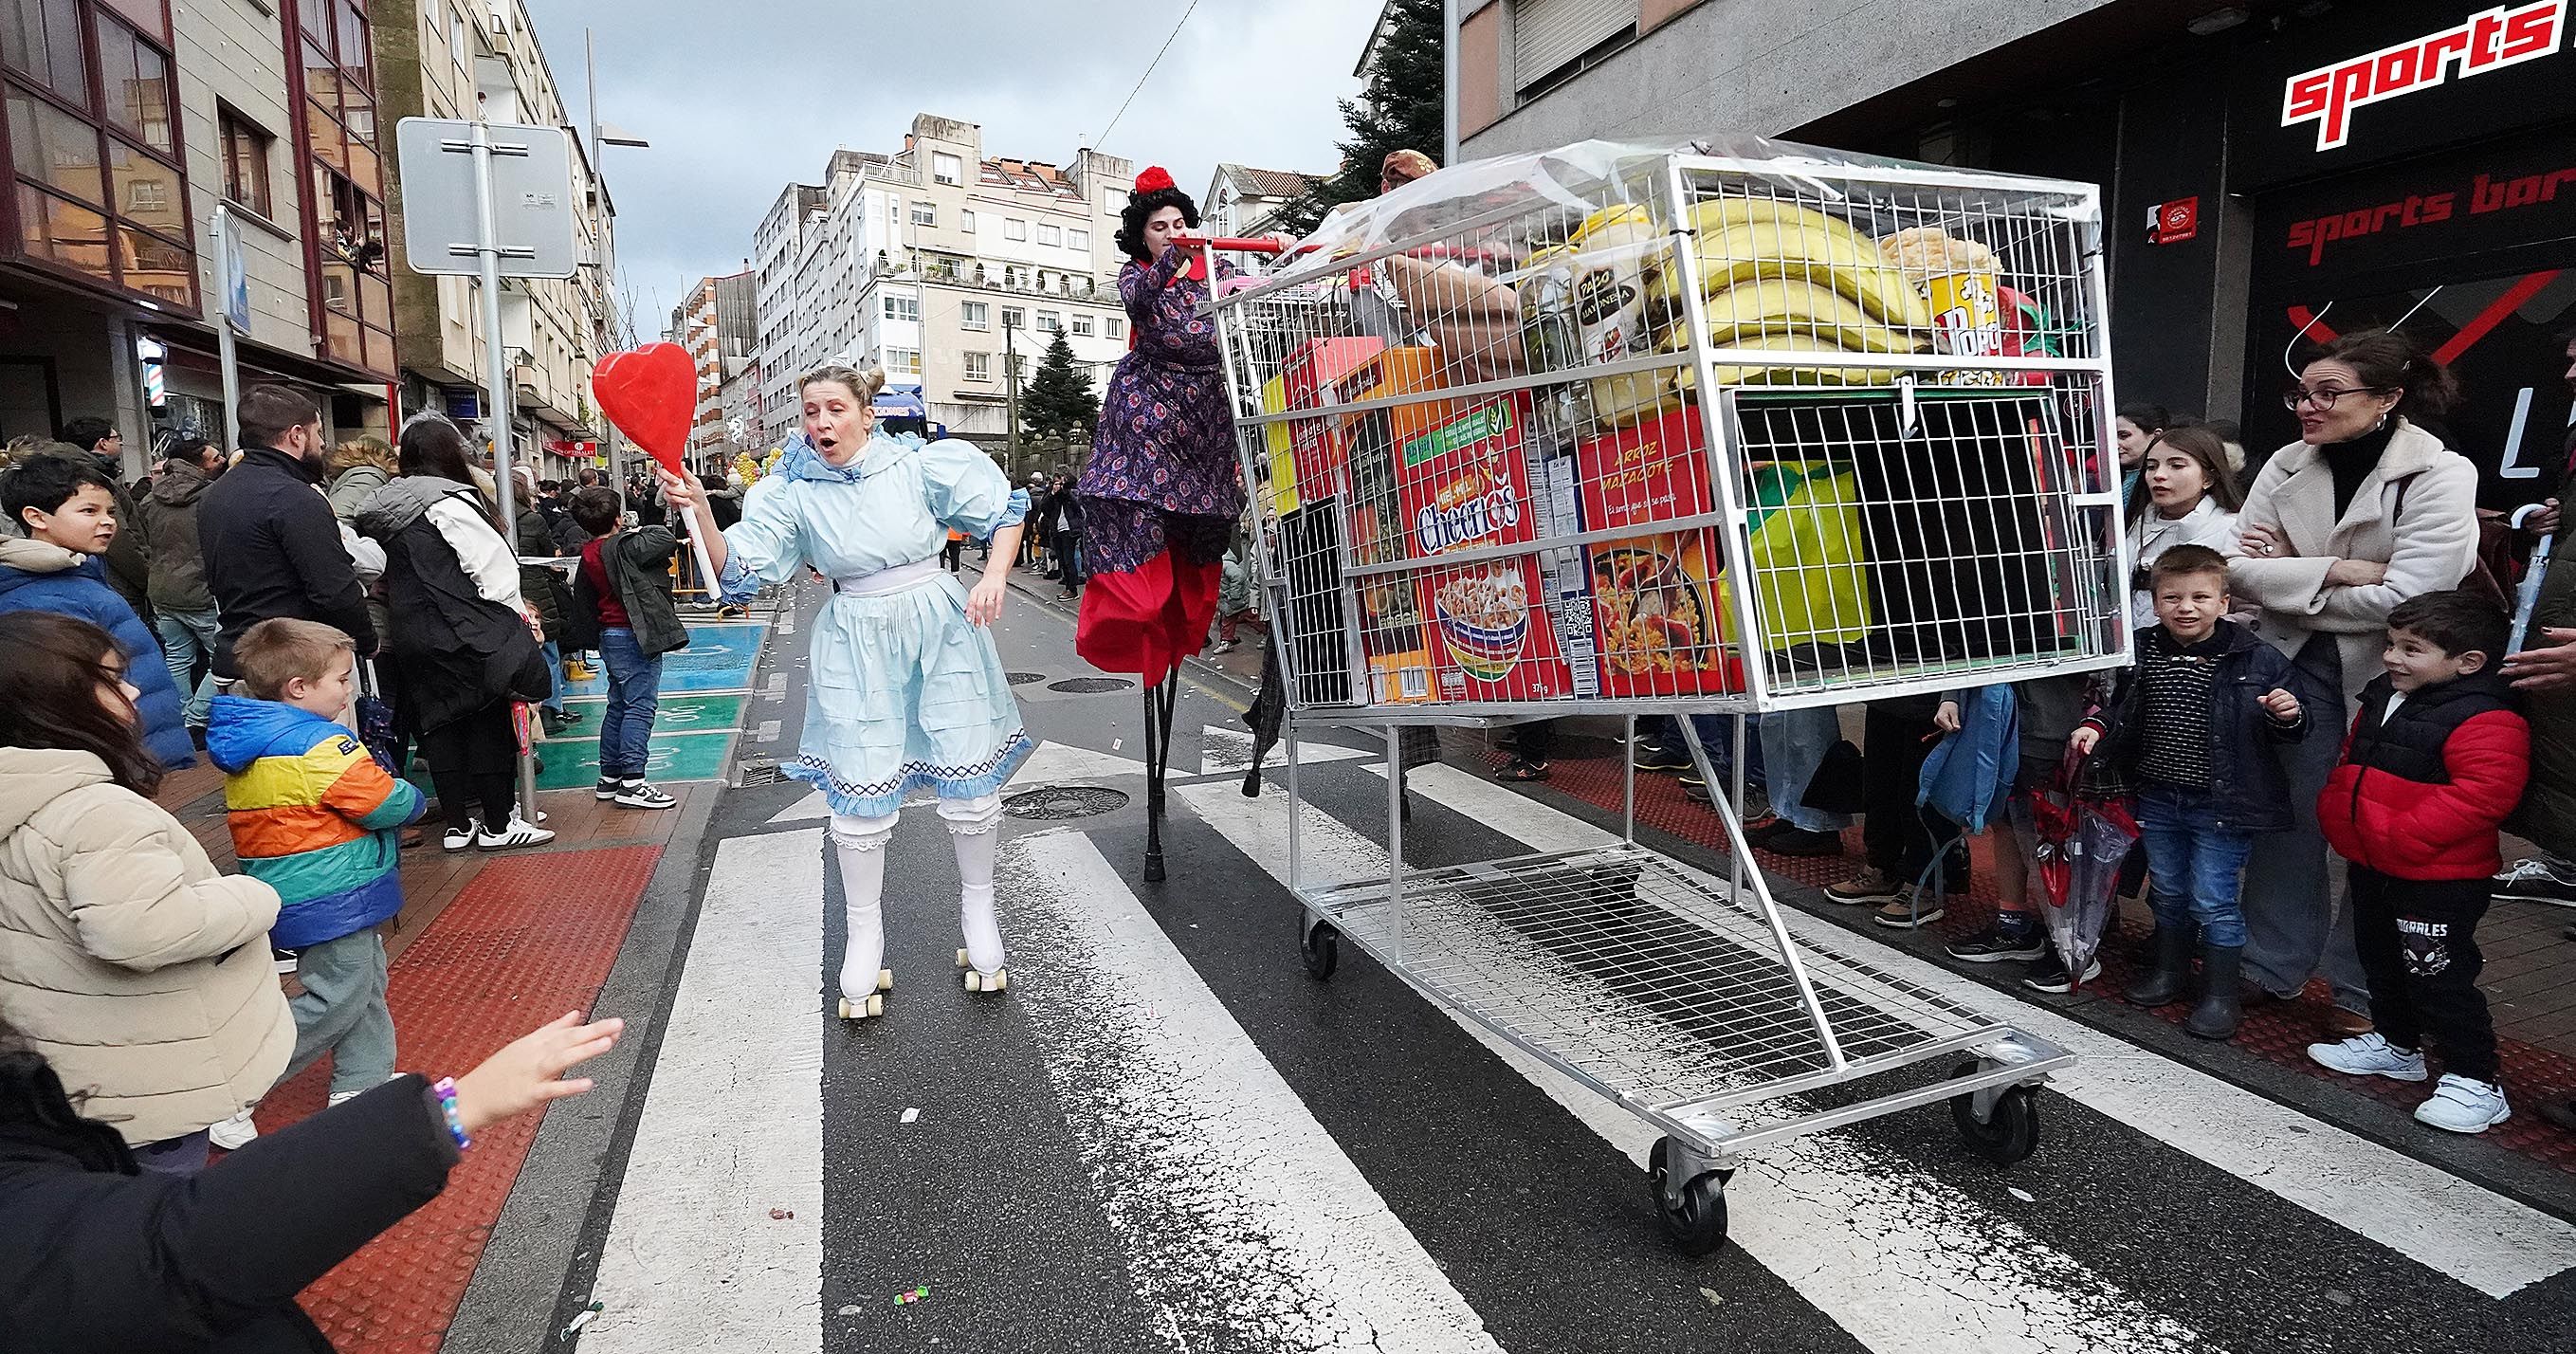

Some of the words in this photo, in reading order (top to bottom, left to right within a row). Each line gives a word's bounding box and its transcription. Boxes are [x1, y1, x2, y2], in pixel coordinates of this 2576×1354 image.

[2282, 0, 2566, 152] sports
[2287, 192, 2457, 265] sports
[2469, 168, 2576, 215] bar
[1581, 289, 1631, 319] MAYONEA
[872, 406, 910, 417] GONES
[1615, 440, 1657, 467] ARROZ
[1599, 459, 1673, 493] MAZACOTE
[1418, 485, 1520, 554] Cheerios
[1531, 683, 1548, 694] 37g
